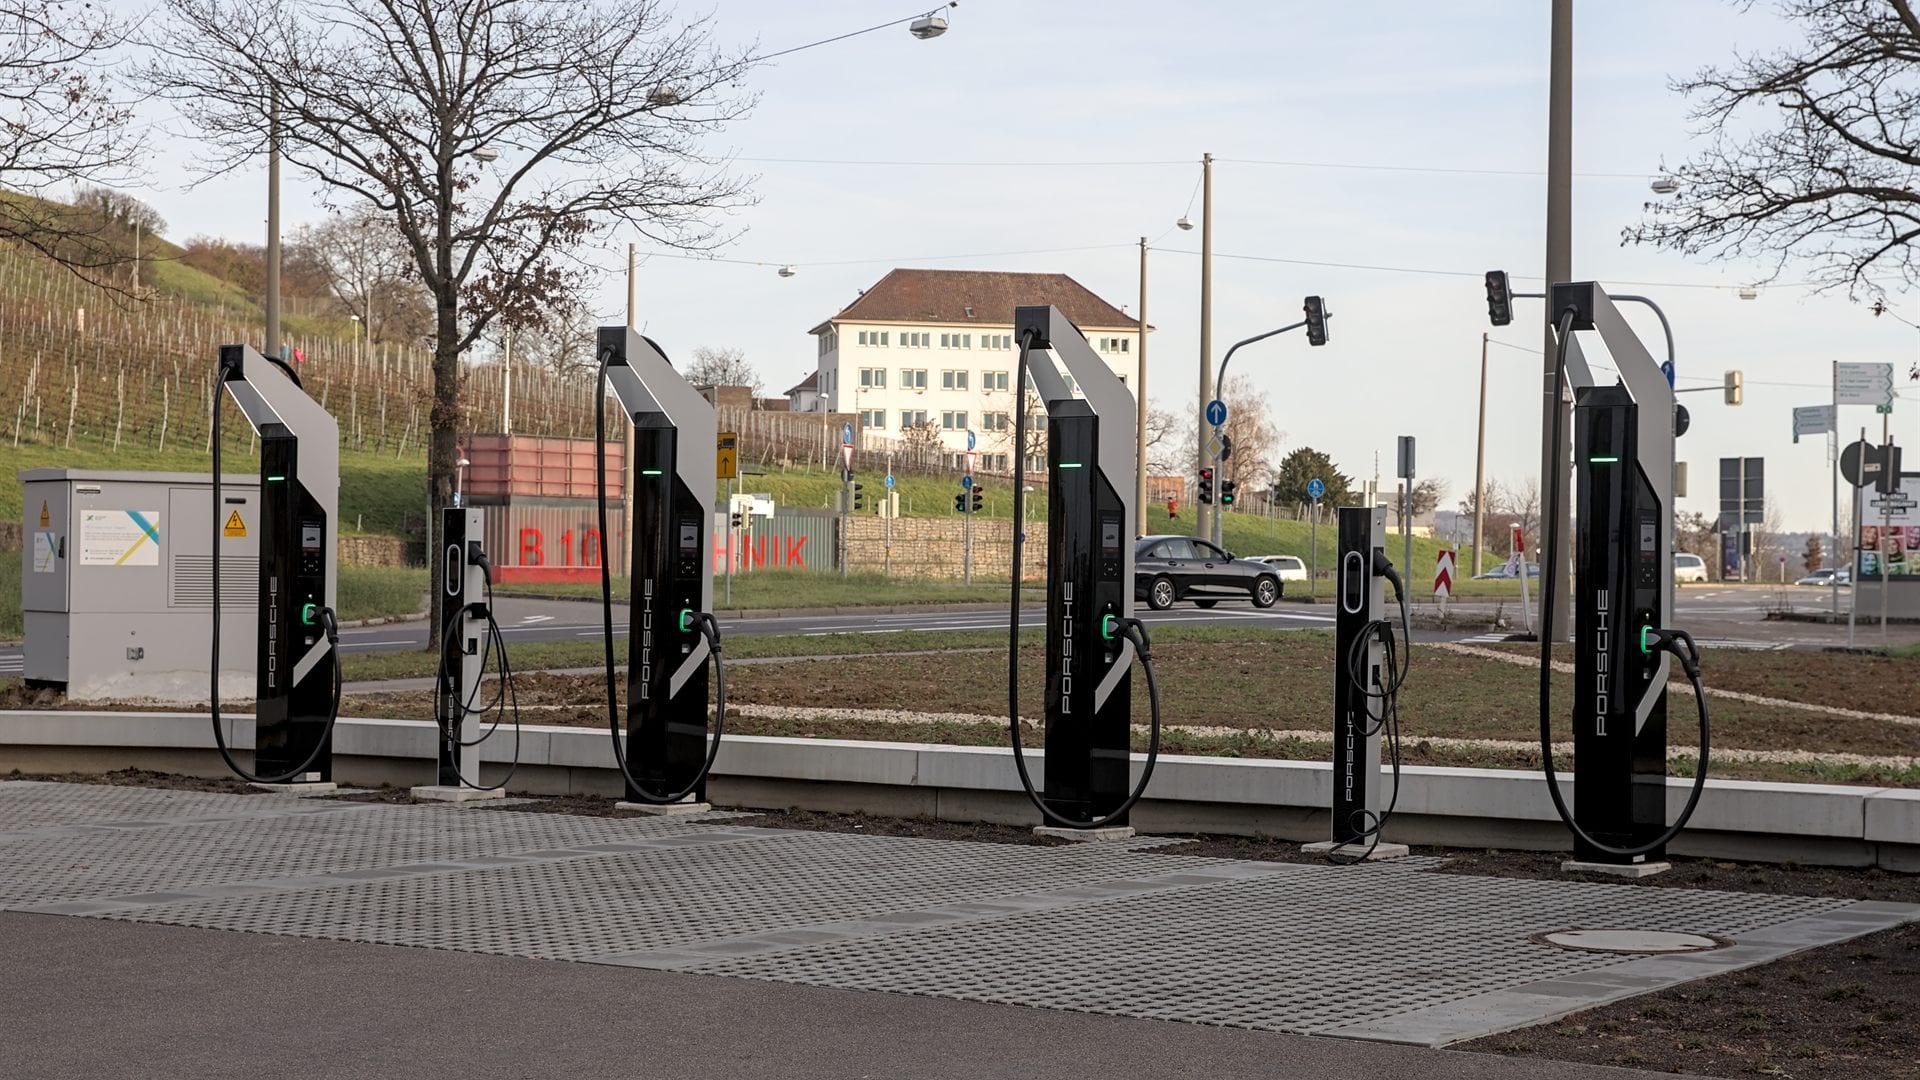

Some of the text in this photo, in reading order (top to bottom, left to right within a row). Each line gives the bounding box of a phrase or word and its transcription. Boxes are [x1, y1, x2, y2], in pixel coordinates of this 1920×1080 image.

[519, 528, 544, 567] B
[268, 576, 278, 688] PORSCHE
[641, 578, 653, 700] PORSCHE
[1062, 581, 1073, 714] PORSCHE
[1596, 589, 1608, 736] PORSCHE
